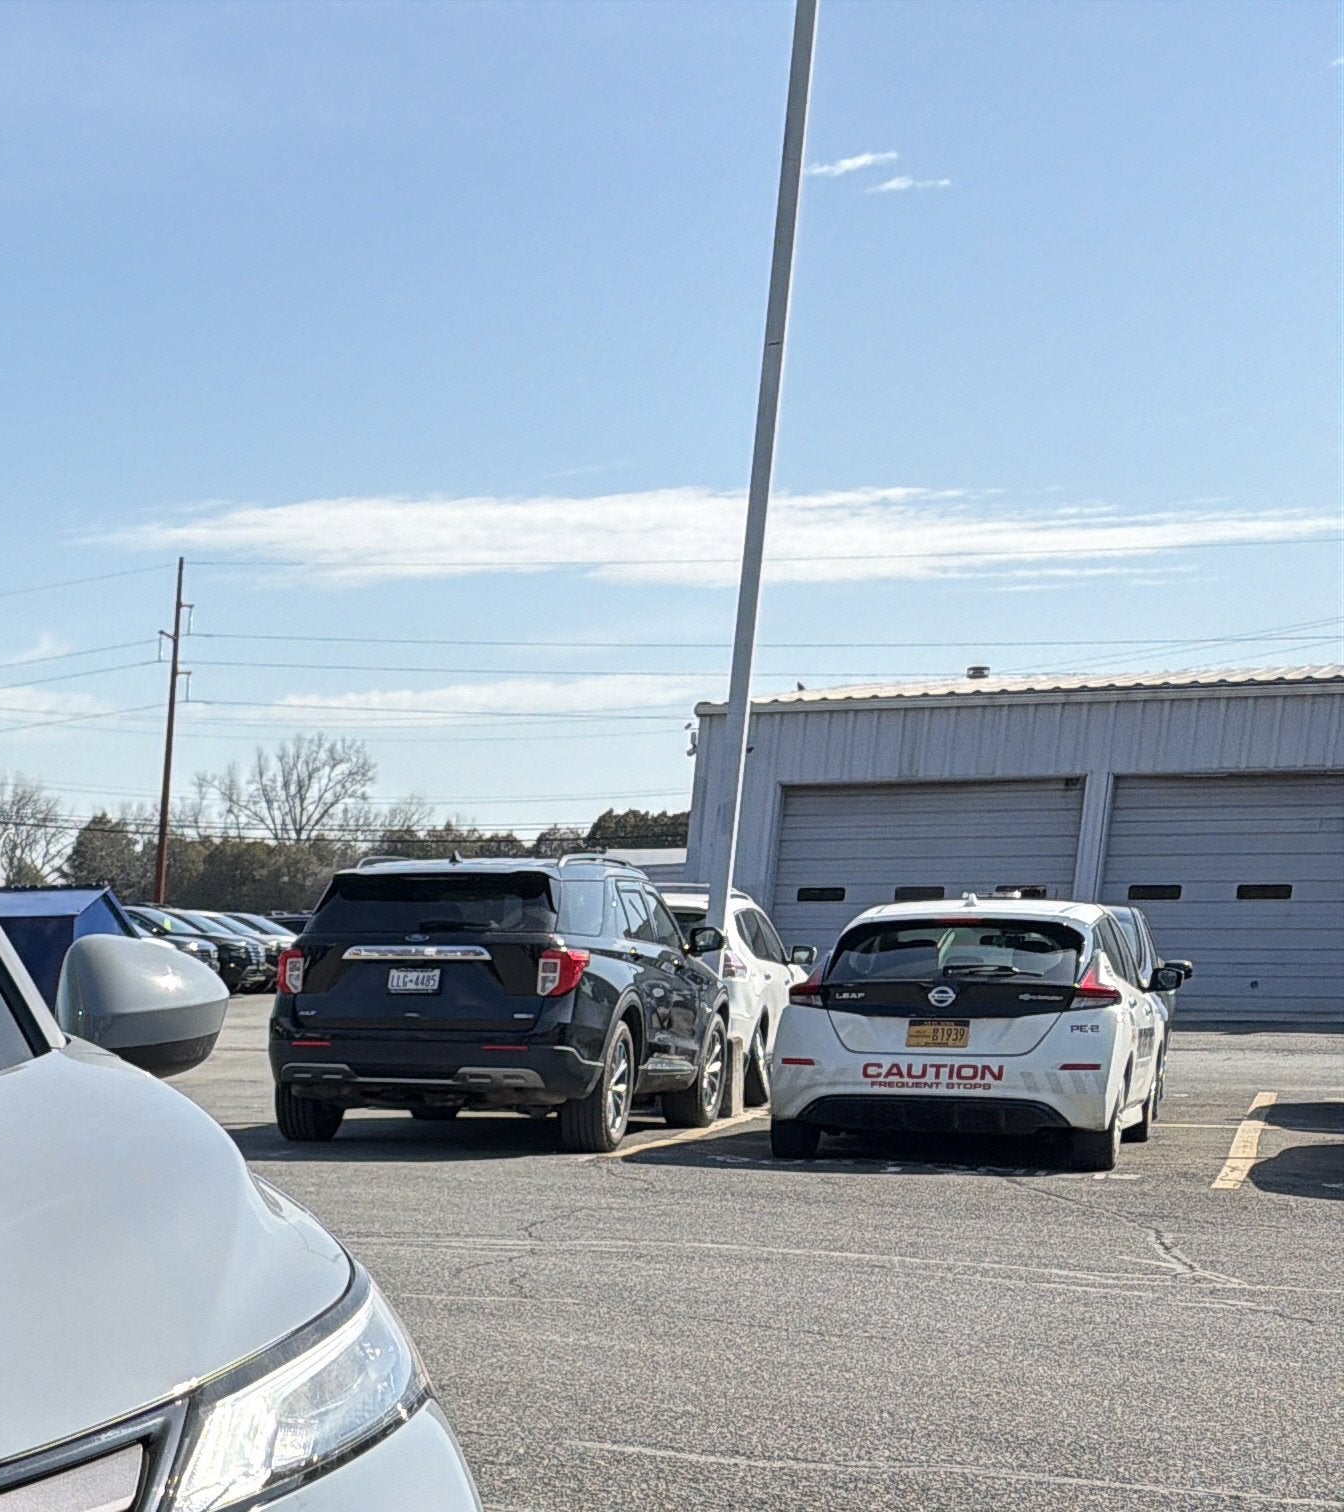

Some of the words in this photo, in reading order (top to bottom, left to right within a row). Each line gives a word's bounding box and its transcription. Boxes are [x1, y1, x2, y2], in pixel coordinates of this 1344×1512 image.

[835, 992, 866, 1000] LEAF
[862, 1062, 1004, 1081] CAUTION
[870, 1081, 942, 1090] FREQUENT
[945, 1082, 992, 1090] STOPS
